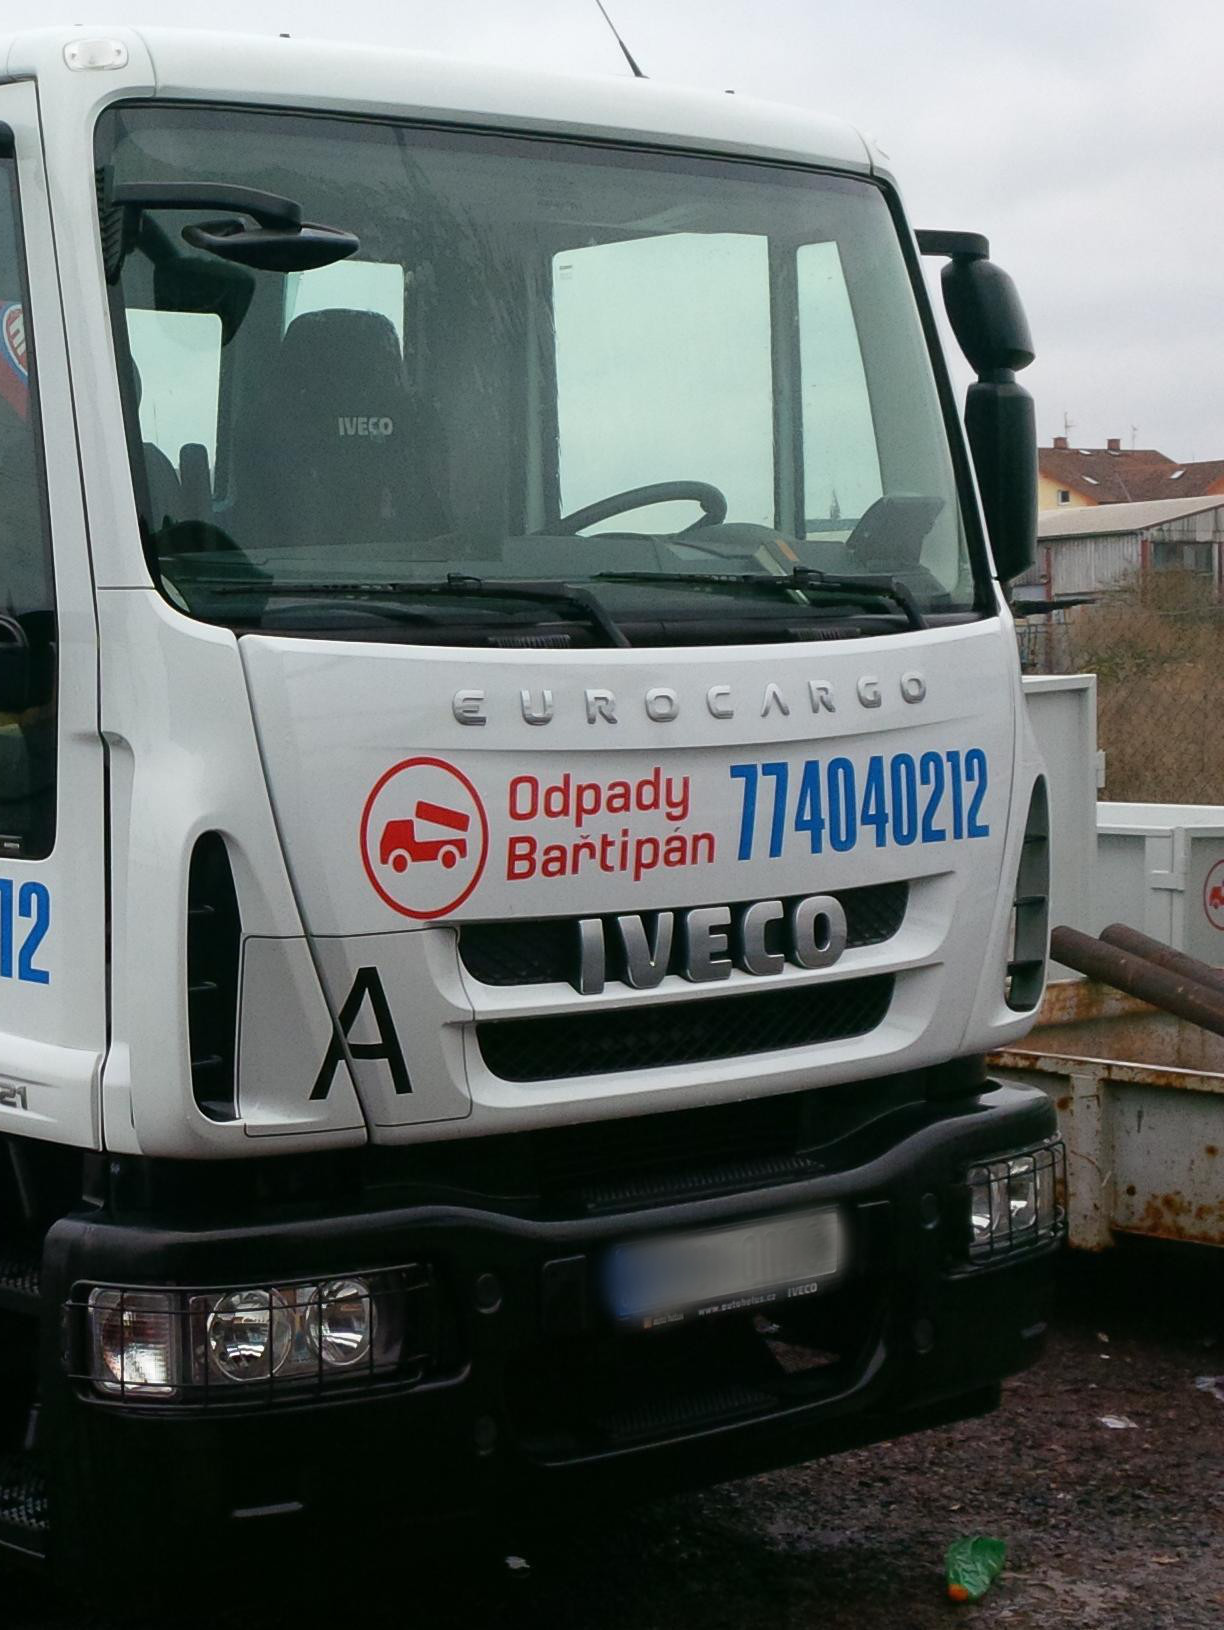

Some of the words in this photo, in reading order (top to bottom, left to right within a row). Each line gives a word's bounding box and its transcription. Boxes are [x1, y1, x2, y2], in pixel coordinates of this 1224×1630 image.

[338, 417, 393, 435] IVECO
[451, 670, 927, 727] EUROCARGO
[509, 766, 690, 822] Odpady
[729, 748, 989, 862] 774040212
[506, 826, 716, 881] Bařtipán
[575, 895, 849, 996] IVECO
[309, 966, 413, 1100] A
[787, 1281, 818, 1298] IVECO
